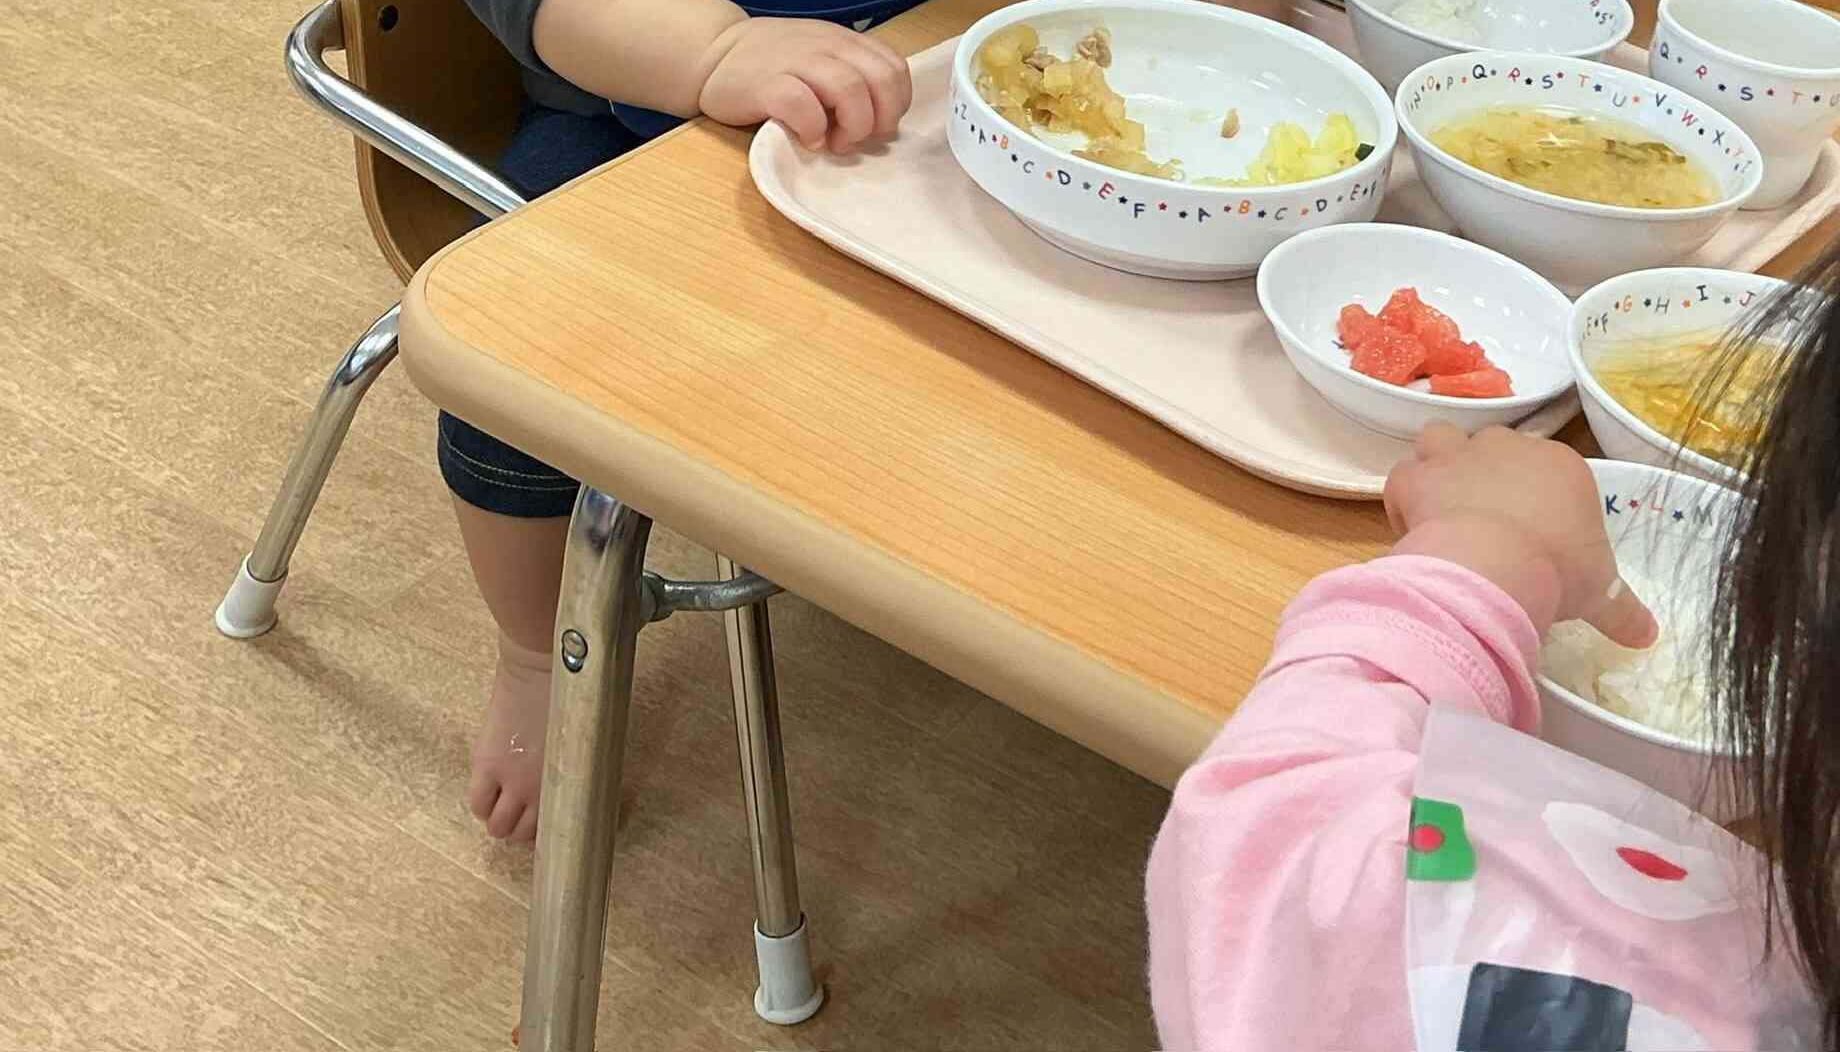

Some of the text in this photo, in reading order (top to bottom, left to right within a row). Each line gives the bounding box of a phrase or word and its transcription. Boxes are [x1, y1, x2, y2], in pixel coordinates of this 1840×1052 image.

[1598, 12, 1608, 25] S
[1659, 41, 1670, 60] Q
[1695, 65, 1708, 80] R
[1739, 86, 1754, 101] S
[1791, 91, 1804, 105] T
[1426, 76, 1435, 91] O
[1446, 76, 1454, 91] P
[1472, 64, 1488, 80] Q
[1508, 67, 1521, 83] R
[1542, 74, 1555, 89] S
[1578, 74, 1591, 89] T
[1612, 91, 1627, 108] U
[1655, 92, 1668, 107] V
[1681, 109, 1699, 128] W
[1711, 129, 1726, 146] X
[978, 128, 987, 145] A
[999, 134, 1009, 149] B
[1022, 160, 1035, 174] C
[1057, 169, 1072, 185] D
[1097, 181, 1115, 200] E
[1133, 202, 1147, 219] F
[1198, 206, 1212, 223] A
[1238, 199, 1250, 214] B
[1274, 206, 1289, 221] C
[1315, 198, 1328, 212] D
[1350, 183, 1361, 201] E
[1621, 294, 1633, 313] G
[1654, 297, 1671, 315] H
[1696, 284, 1709, 302] I
[1738, 290, 1757, 309] J
[1604, 489, 1713, 526] K L M
